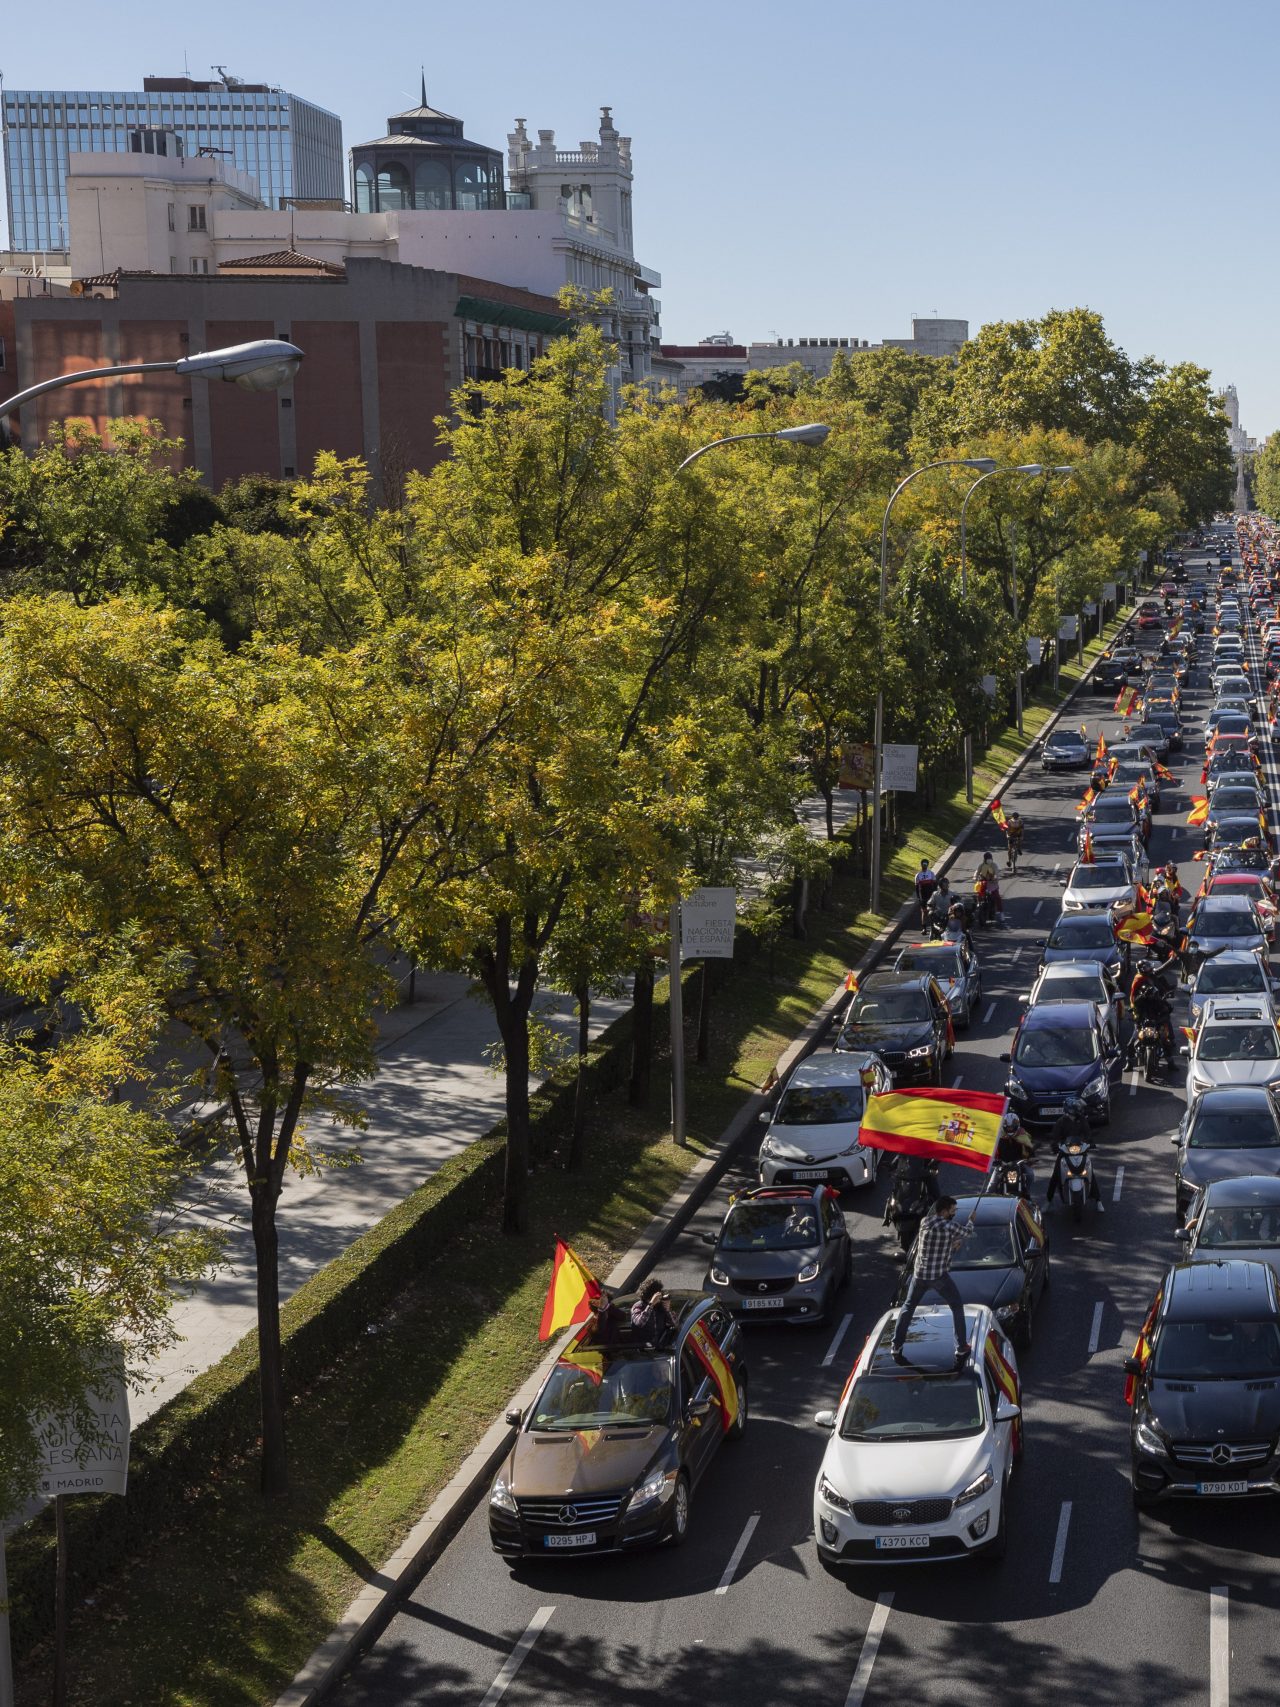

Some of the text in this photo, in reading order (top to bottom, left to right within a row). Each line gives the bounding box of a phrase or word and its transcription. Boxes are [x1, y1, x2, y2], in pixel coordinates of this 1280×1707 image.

[700, 935, 732, 943] ESPAÑA
[57, 1478, 104, 1488] MADRID
[1203, 1482, 1245, 1492] 8790 KDT
[551, 1534, 594, 1545] 0295 HPJ
[882, 1537, 928, 1547] 4370 KCC
